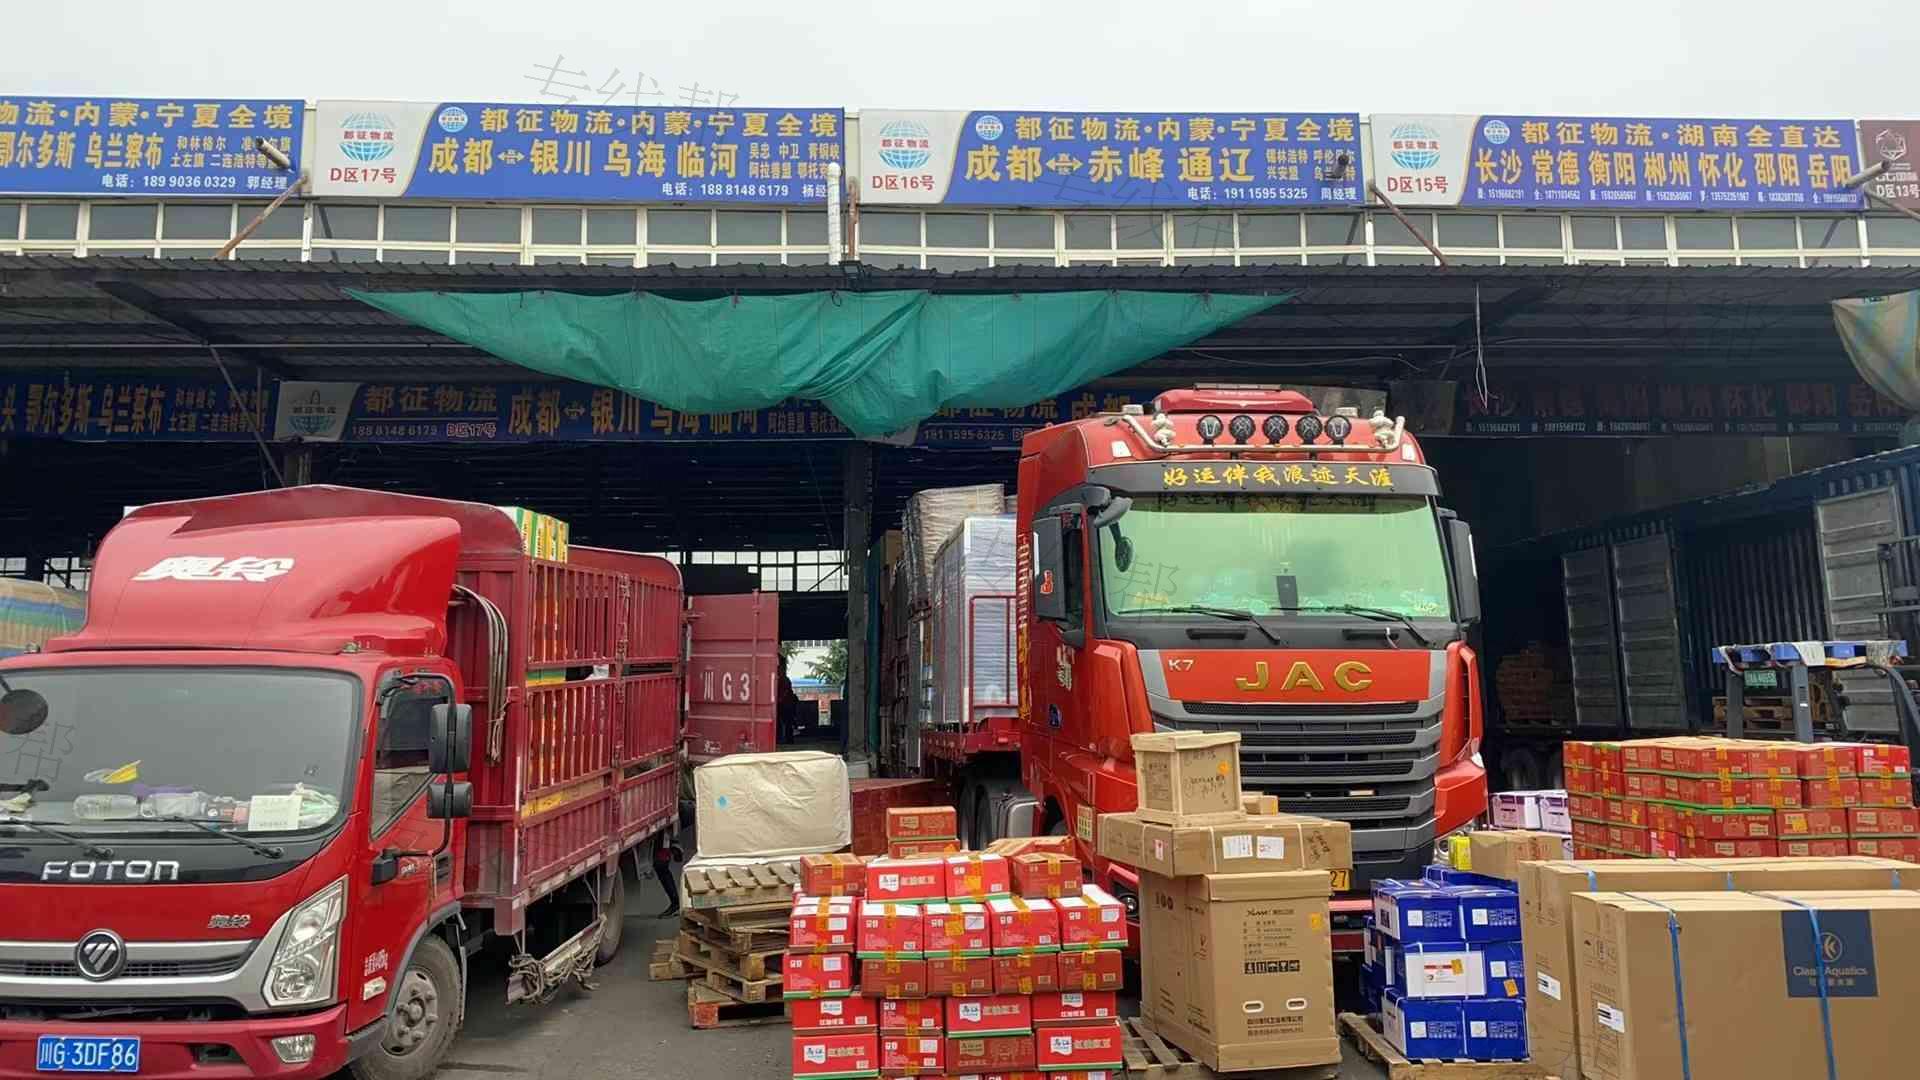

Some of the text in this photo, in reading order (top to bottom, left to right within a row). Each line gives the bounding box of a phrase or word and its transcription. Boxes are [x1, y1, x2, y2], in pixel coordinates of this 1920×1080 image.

[344, 131, 394, 141] 都征物流
[1522, 121, 1841, 148] 都征物流·湖南全直达
[85, 131, 164, 170] 乌兰察布
[429, 137, 739, 178] 成都 银川 乌海 临河
[778, 142, 800, 160] 中卫
[965, 144, 1255, 183] 成都 赤峰 通辽
[1475, 148, 1522, 185] 长沙
[1532, 149, 1580, 186] 常德
[1588, 150, 1637, 186] 衡阳
[1643, 152, 1691, 187] 郴州
[1698, 152, 1747, 188] 怀化
[1754, 152, 1800, 188] 邵阳
[1808, 154, 1851, 189] 岳阳
[143, 176, 166, 188] 189
[168, 176, 201, 188] 9036
[204, 176, 236, 188] 0329
[330, 168, 397, 184] D区17号
[872, 175, 935, 190] D区16号
[1387, 176, 1448, 194] D区15号
[701, 185, 722, 196] 188
[725, 185, 755, 196] 8148
[758, 185, 789, 197] 6179
[802, 184, 829, 197] 杨经
[1224, 188, 1245, 199] 191
[1249, 188, 1277, 199] 1595
[1279, 188, 1308, 199] 5325
[1877, 185, 1920, 199] D区13号
[365, 385, 497, 412] 都征物流
[509, 387, 560, 435] 成都
[591, 389, 640, 435] 银川
[1163, 464, 1393, 488] 好运伴我浪迹天涯
[1168, 659, 1194, 673] K7
[1235, 660, 1374, 692] JAC
[41, 860, 180, 881] FOTON
